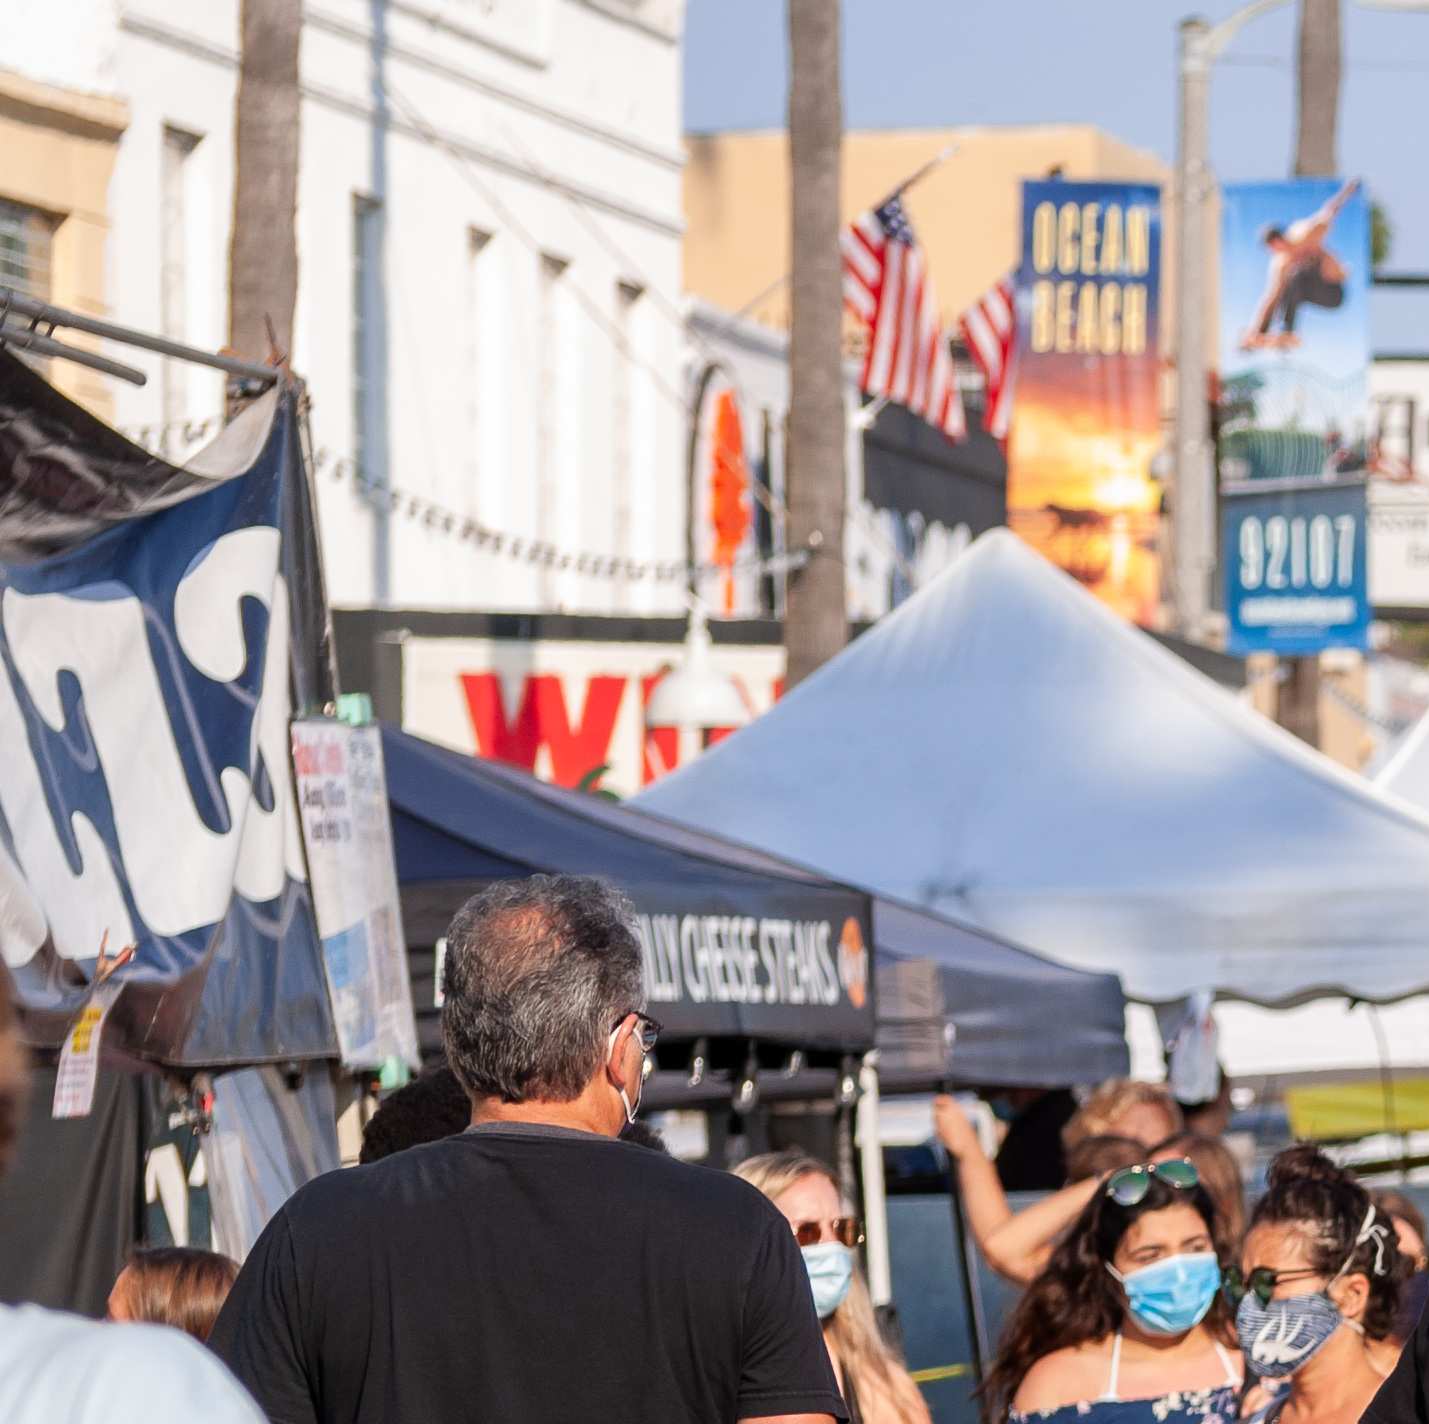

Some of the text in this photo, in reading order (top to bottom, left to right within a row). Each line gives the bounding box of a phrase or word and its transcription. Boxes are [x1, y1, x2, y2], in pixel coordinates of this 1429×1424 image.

[1032, 200, 1150, 275] OCEAN
[1031, 282, 1149, 356] BEACH
[1240, 514, 1356, 590] 92107
[681, 914, 763, 1004] CHEESE
[759, 917, 840, 1006] STEAKS
